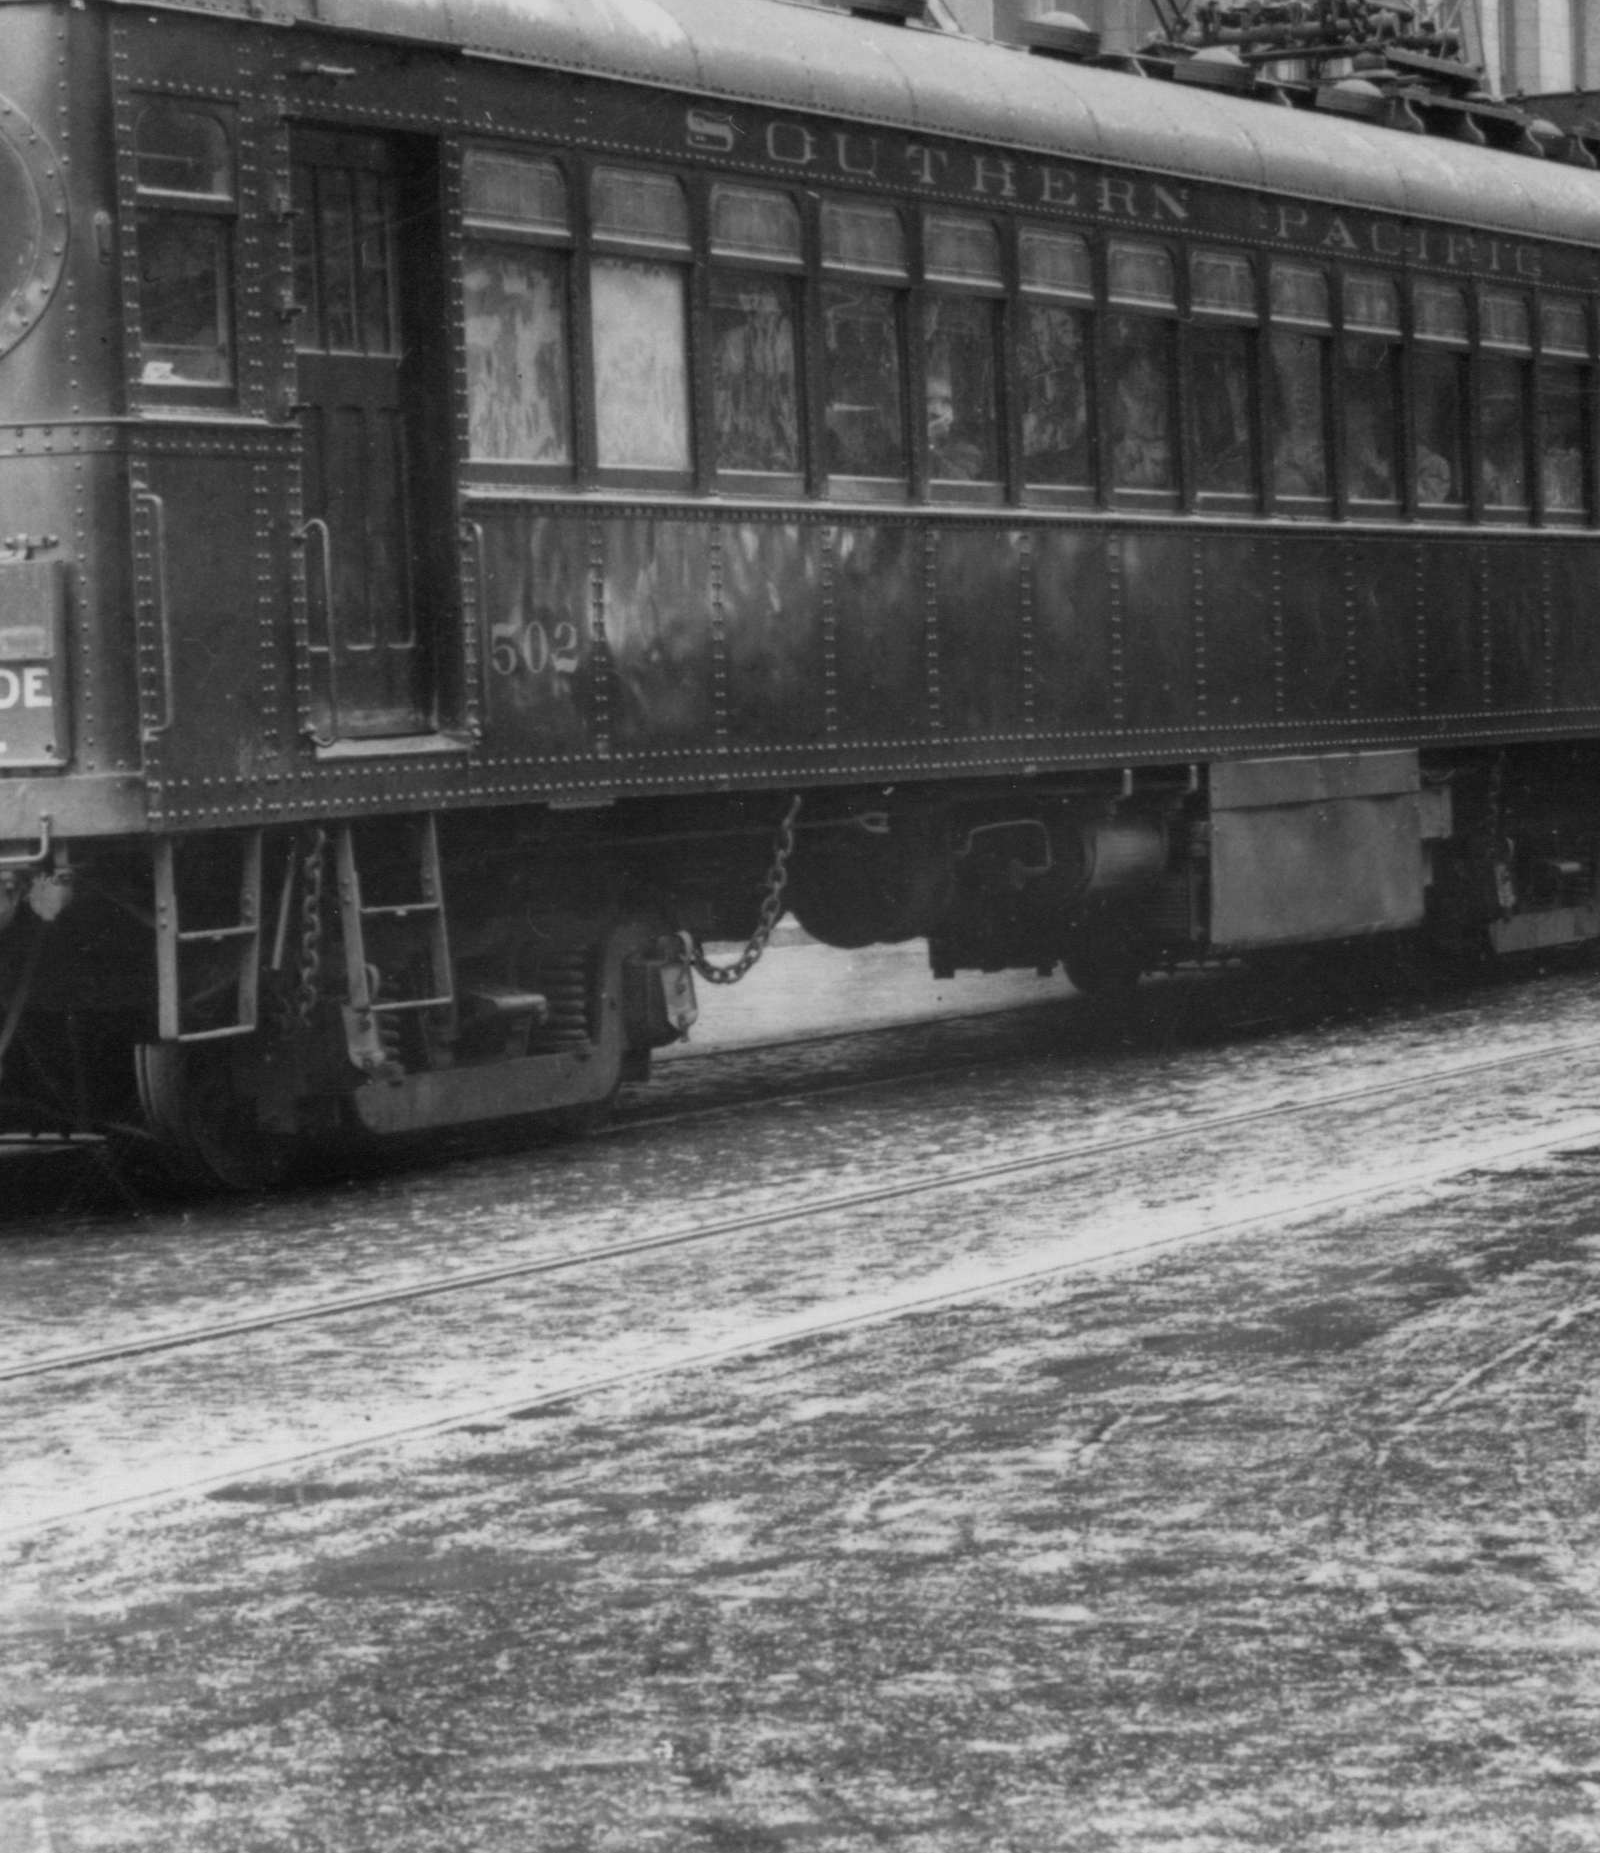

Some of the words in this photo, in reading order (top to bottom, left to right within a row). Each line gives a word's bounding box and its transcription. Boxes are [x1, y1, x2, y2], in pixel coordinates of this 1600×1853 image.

[686, 108, 1189, 221] SOUTHERN
[1274, 204, 1543, 278] PACIFIC
[490, 620, 580, 676] 502
